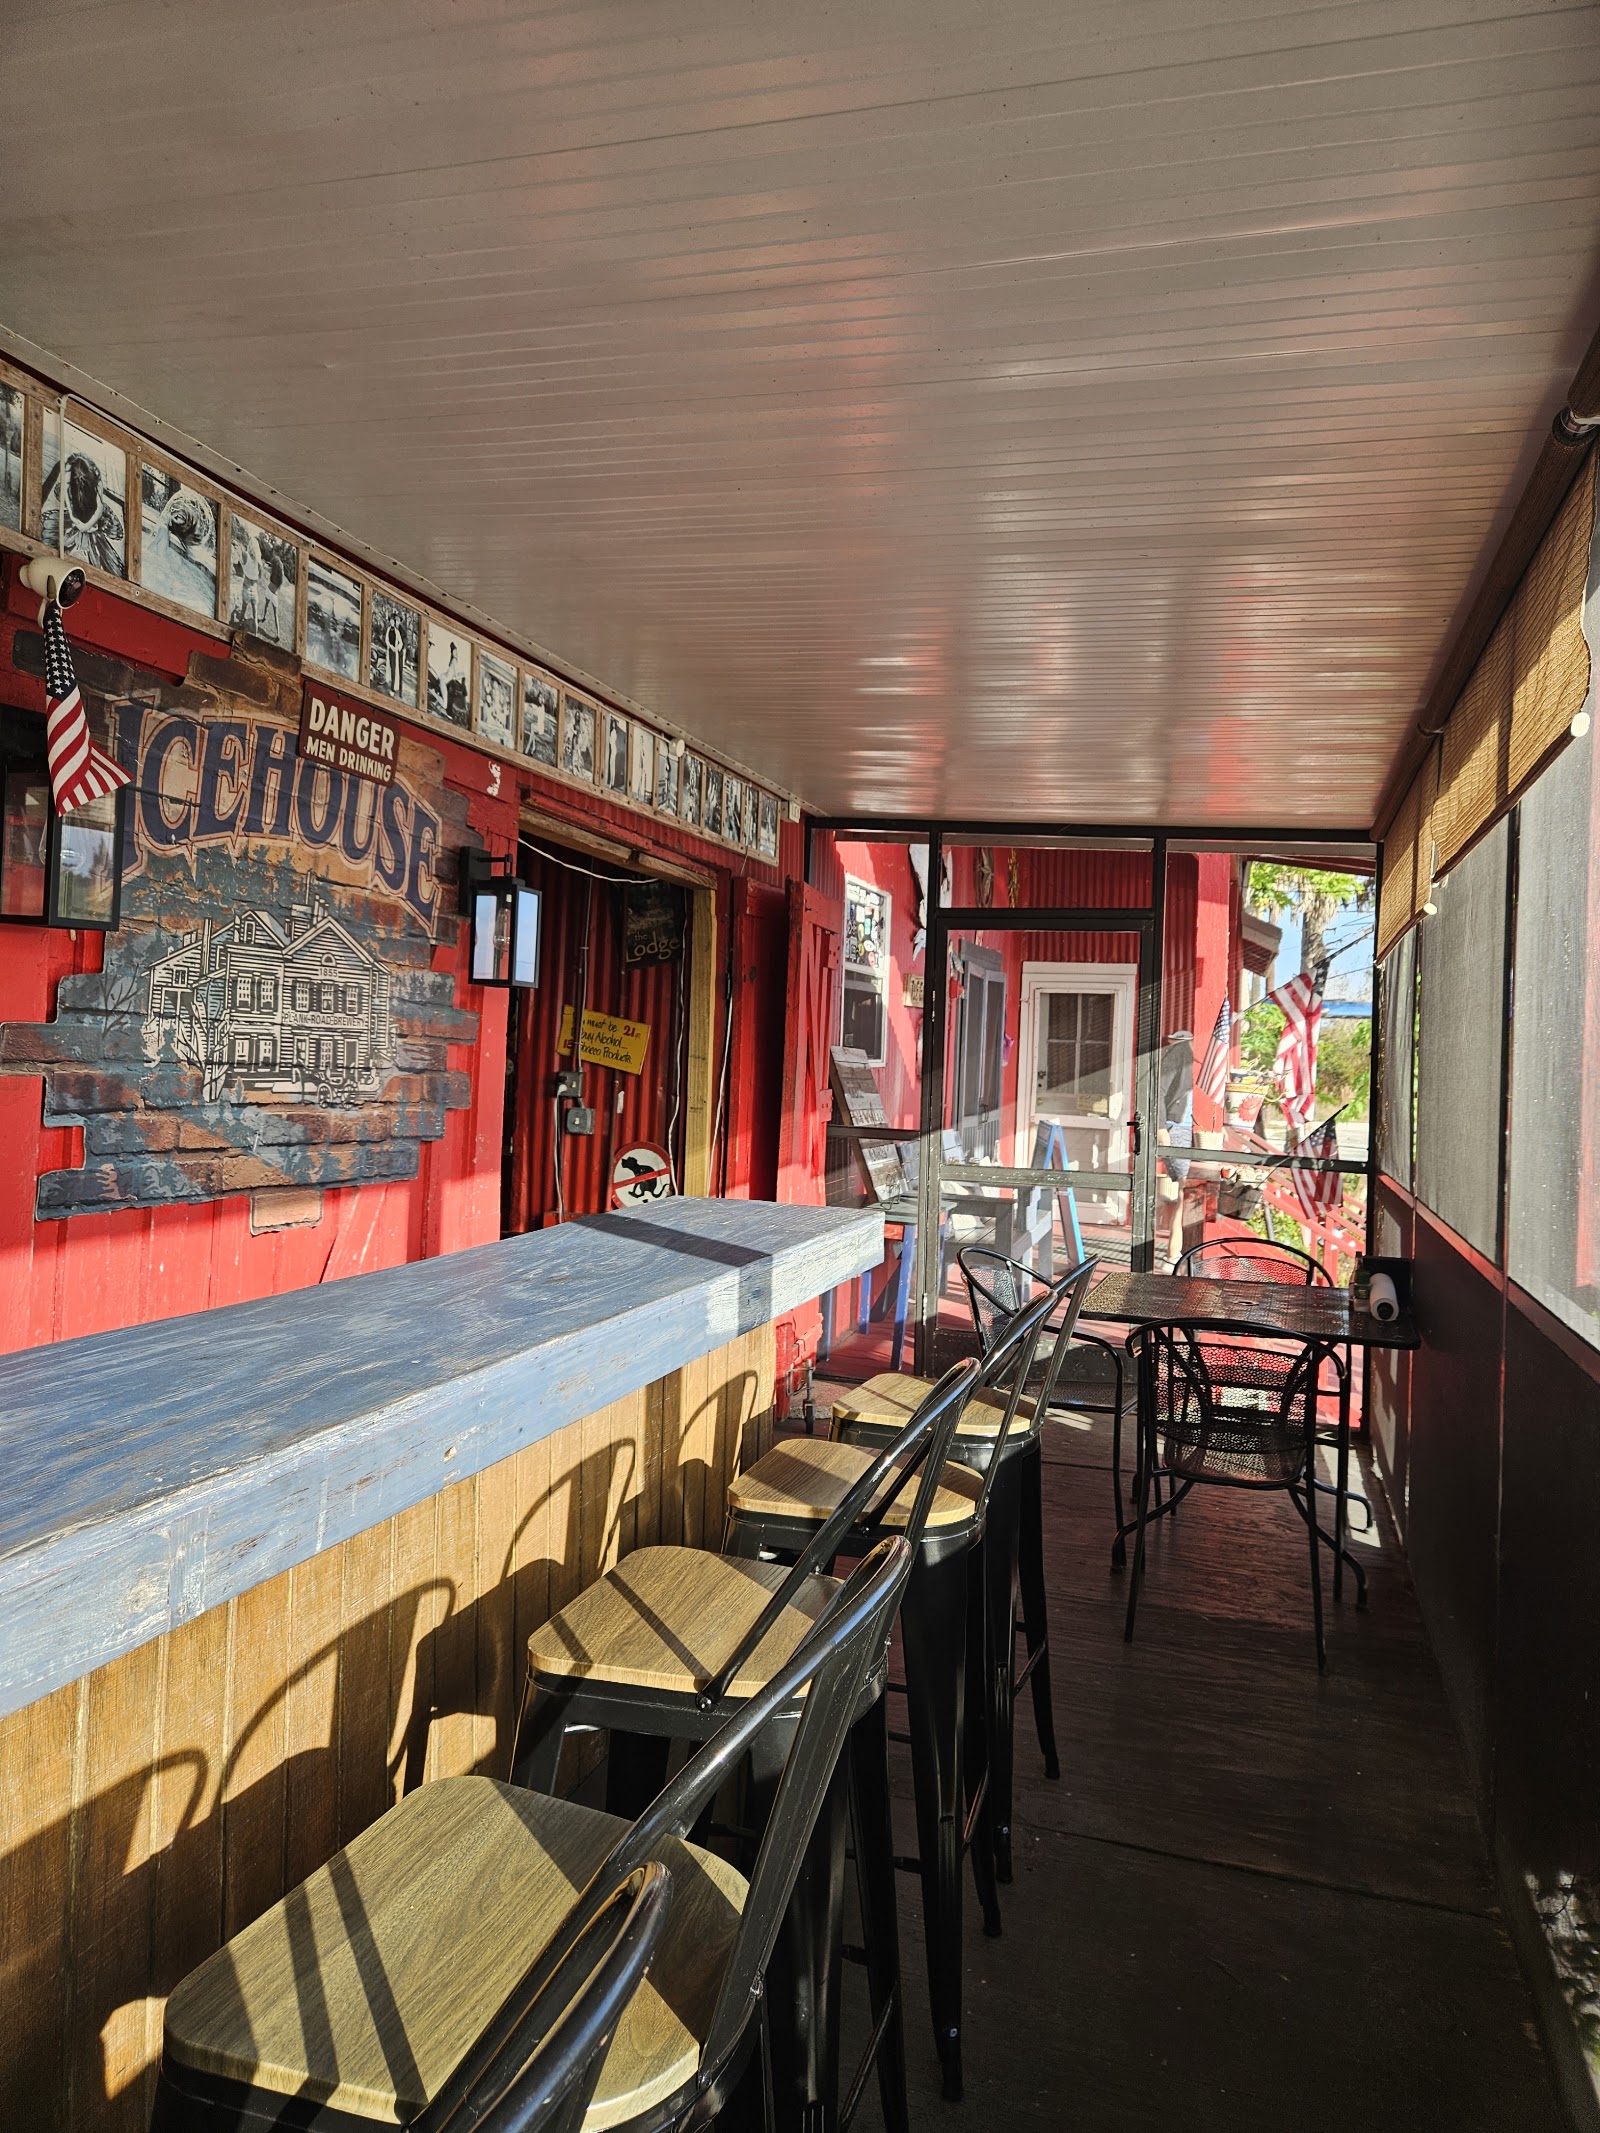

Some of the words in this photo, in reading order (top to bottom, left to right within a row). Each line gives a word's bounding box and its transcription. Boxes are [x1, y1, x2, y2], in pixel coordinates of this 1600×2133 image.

[308, 696, 395, 761] DANGER
[305, 735, 335, 763] MEN
[338, 748, 393, 783] DRINKING
[106, 697, 444, 938] ICEHOUSE
[625, 929, 681, 963] Lodge
[319, 967, 338, 978] 1855
[587, 1018, 606, 1030] must
[608, 1021, 617, 1033] be
[623, 1025, 636, 1038] 21
